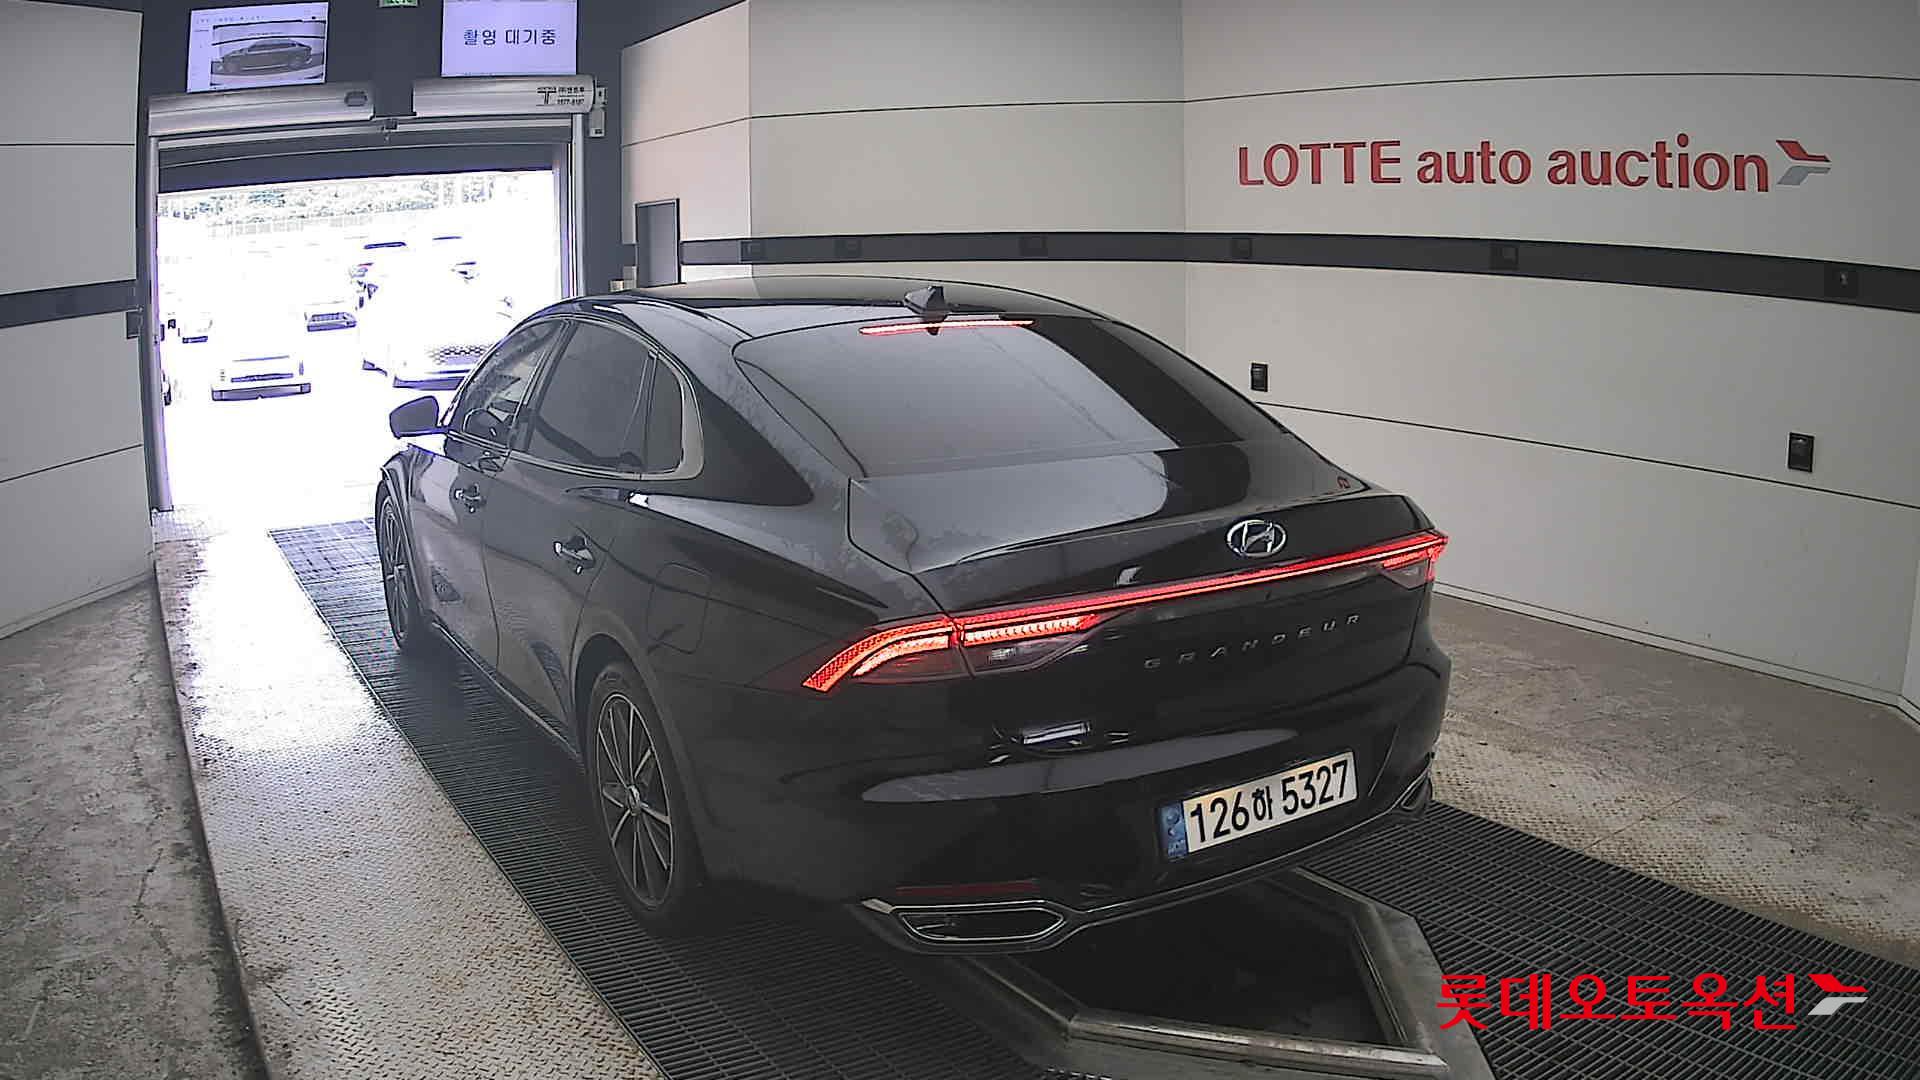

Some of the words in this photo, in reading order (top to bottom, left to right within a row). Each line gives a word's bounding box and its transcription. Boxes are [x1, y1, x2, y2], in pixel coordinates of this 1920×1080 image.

[505, 29, 556, 46] 대기중
[1239, 140, 1400, 187] LOTTE
[1417, 140, 1532, 184] auto
[1547, 133, 1769, 193] auction
[1144, 614, 1360, 670] GRANDEUR
[1190, 785, 1273, 843] 126하
[1280, 759, 1349, 816] 5327
